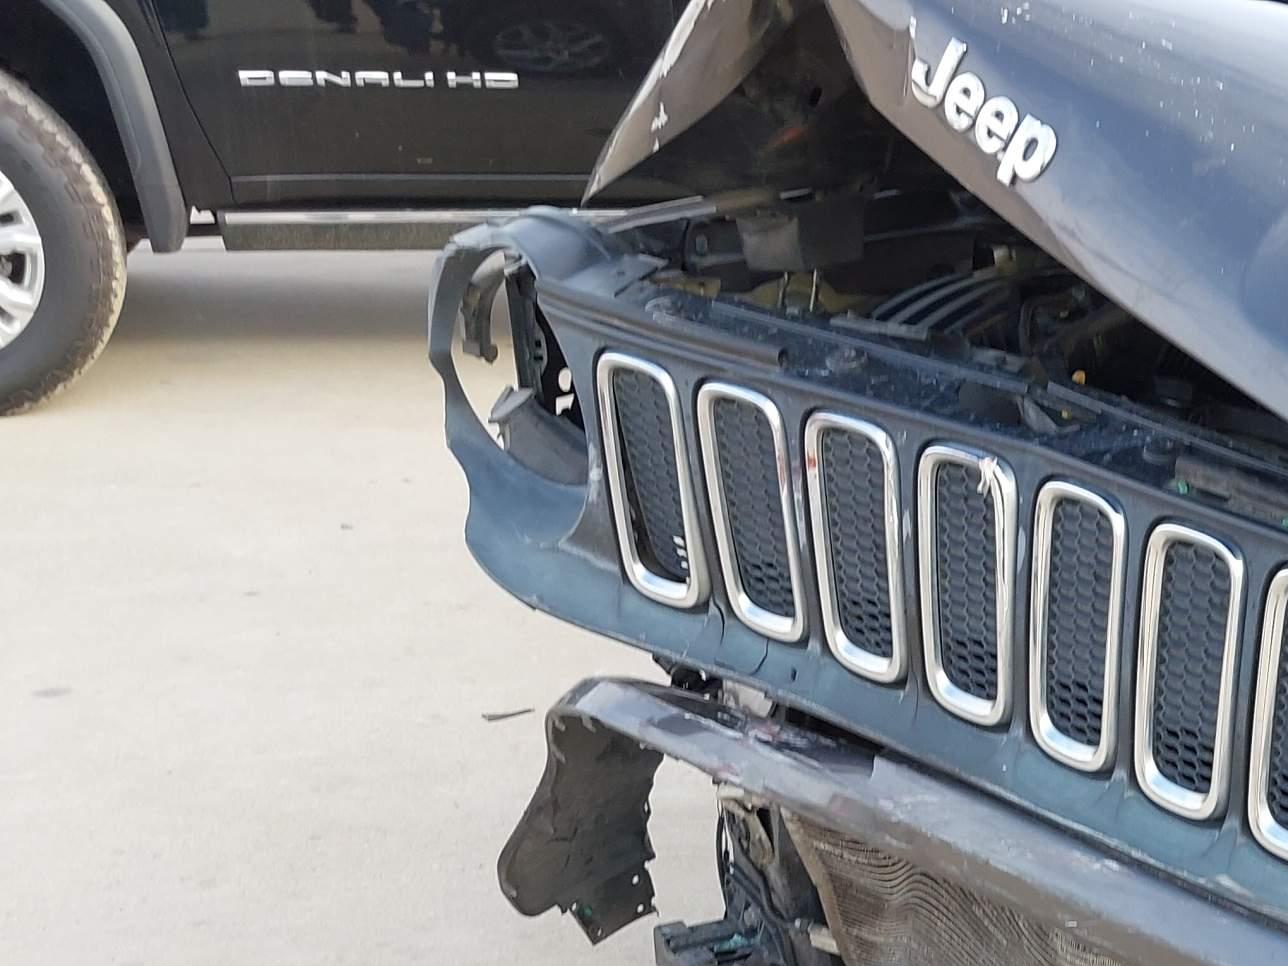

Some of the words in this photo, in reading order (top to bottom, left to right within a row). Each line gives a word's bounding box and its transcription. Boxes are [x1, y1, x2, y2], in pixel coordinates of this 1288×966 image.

[238, 69, 435, 88] DENALI
[446, 71, 519, 88] HD
[911, 36, 1057, 187] Jeep
